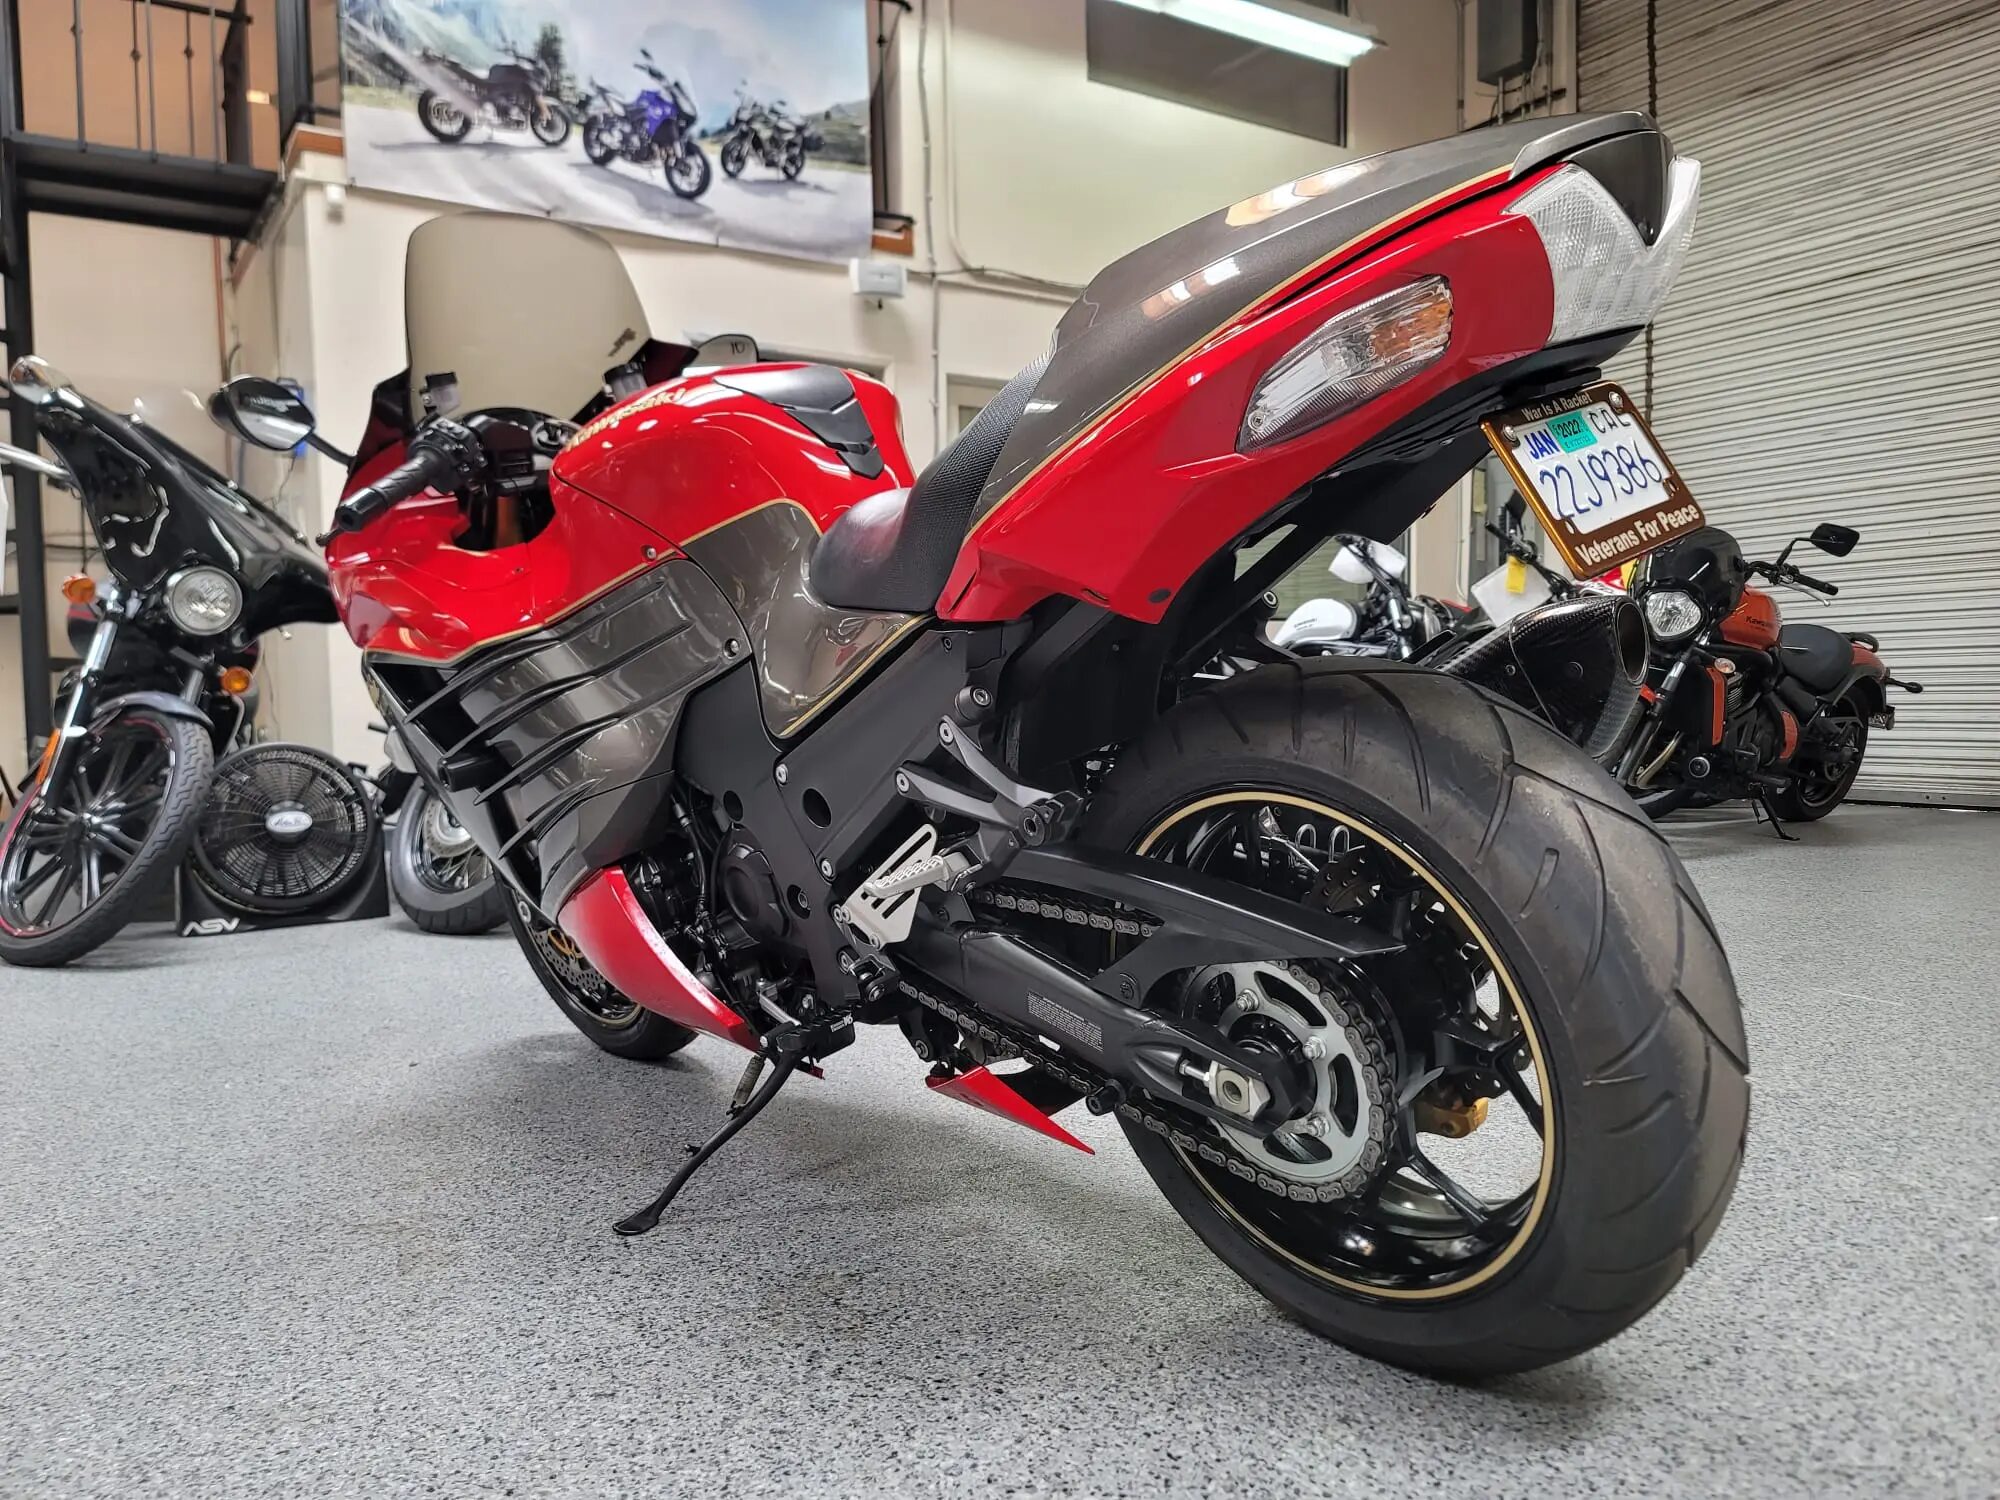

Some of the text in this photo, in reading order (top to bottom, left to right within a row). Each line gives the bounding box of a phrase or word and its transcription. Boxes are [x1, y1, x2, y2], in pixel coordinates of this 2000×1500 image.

[1521, 391, 1593, 421] War Is A Racket
[1524, 428, 1560, 459] JAN
[1558, 418, 1581, 438] 2022
[1539, 439, 1662, 519] 22J9386
[1574, 503, 1700, 566] Veterans For Peace
